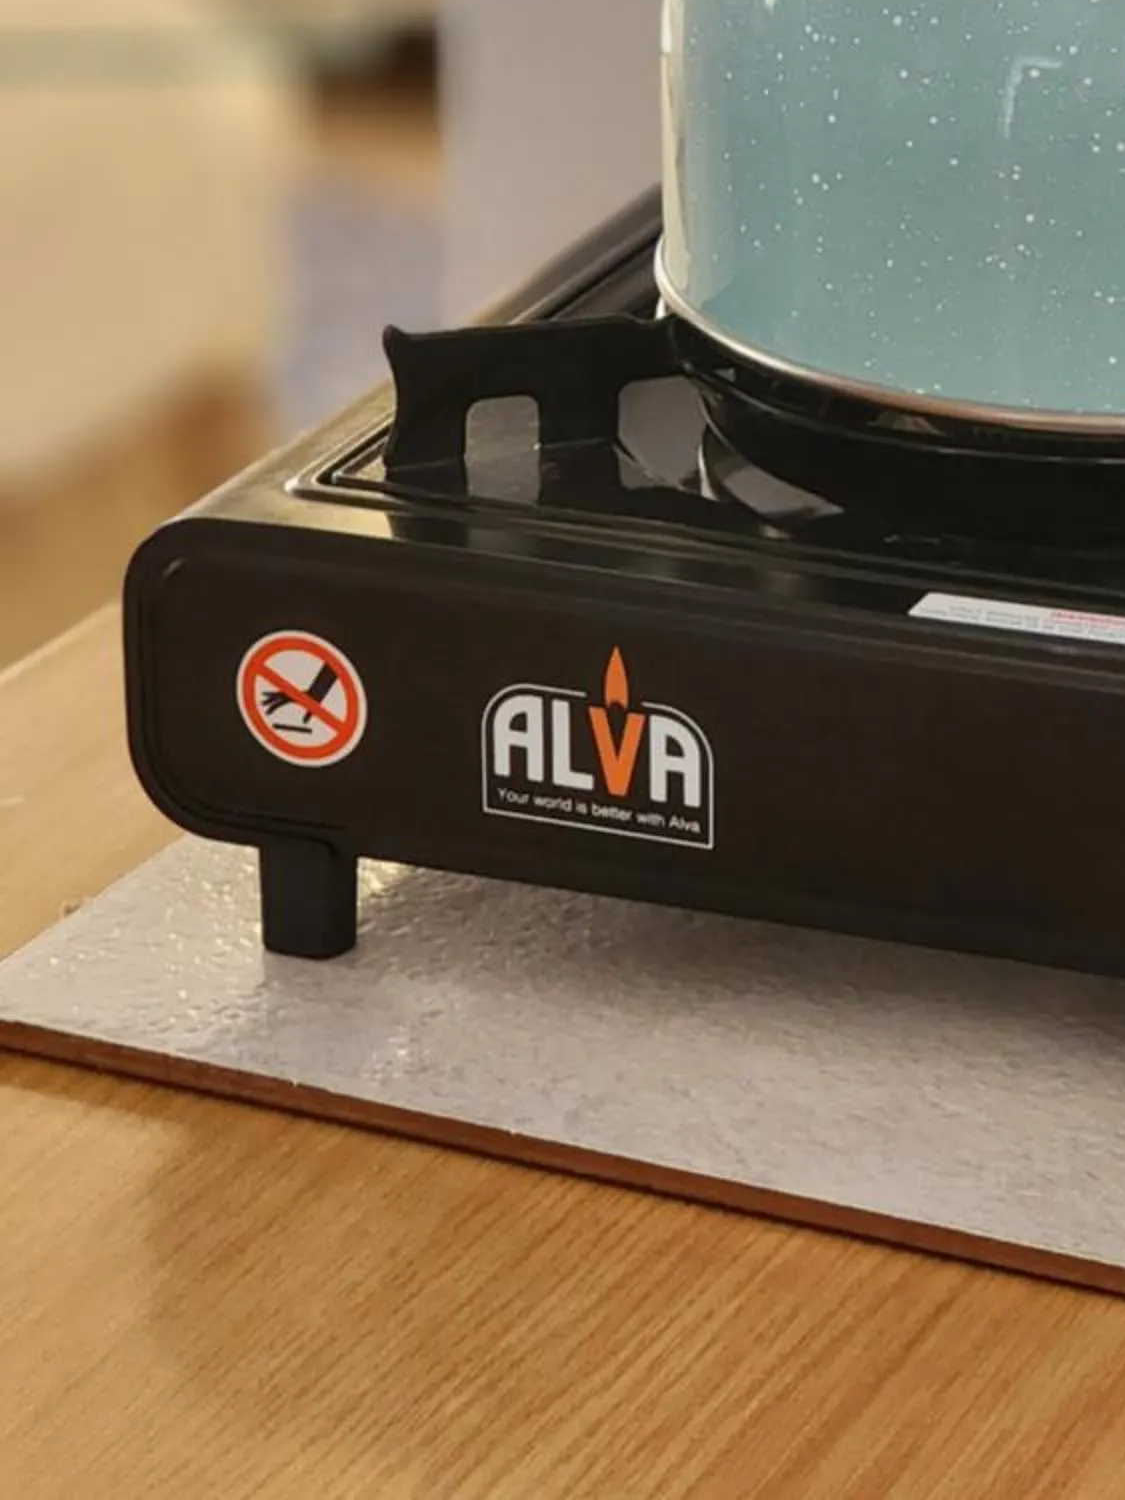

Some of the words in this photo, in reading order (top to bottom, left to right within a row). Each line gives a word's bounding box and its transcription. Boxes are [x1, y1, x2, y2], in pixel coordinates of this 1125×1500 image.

[493, 694, 700, 808] ALVA
[497, 787, 529, 804] Your
[533, 795, 573, 812] world
[576, 802, 588, 815] is
[591, 802, 633, 821] better
[635, 812, 666, 827] with
[668, 815, 700, 833] Alva
